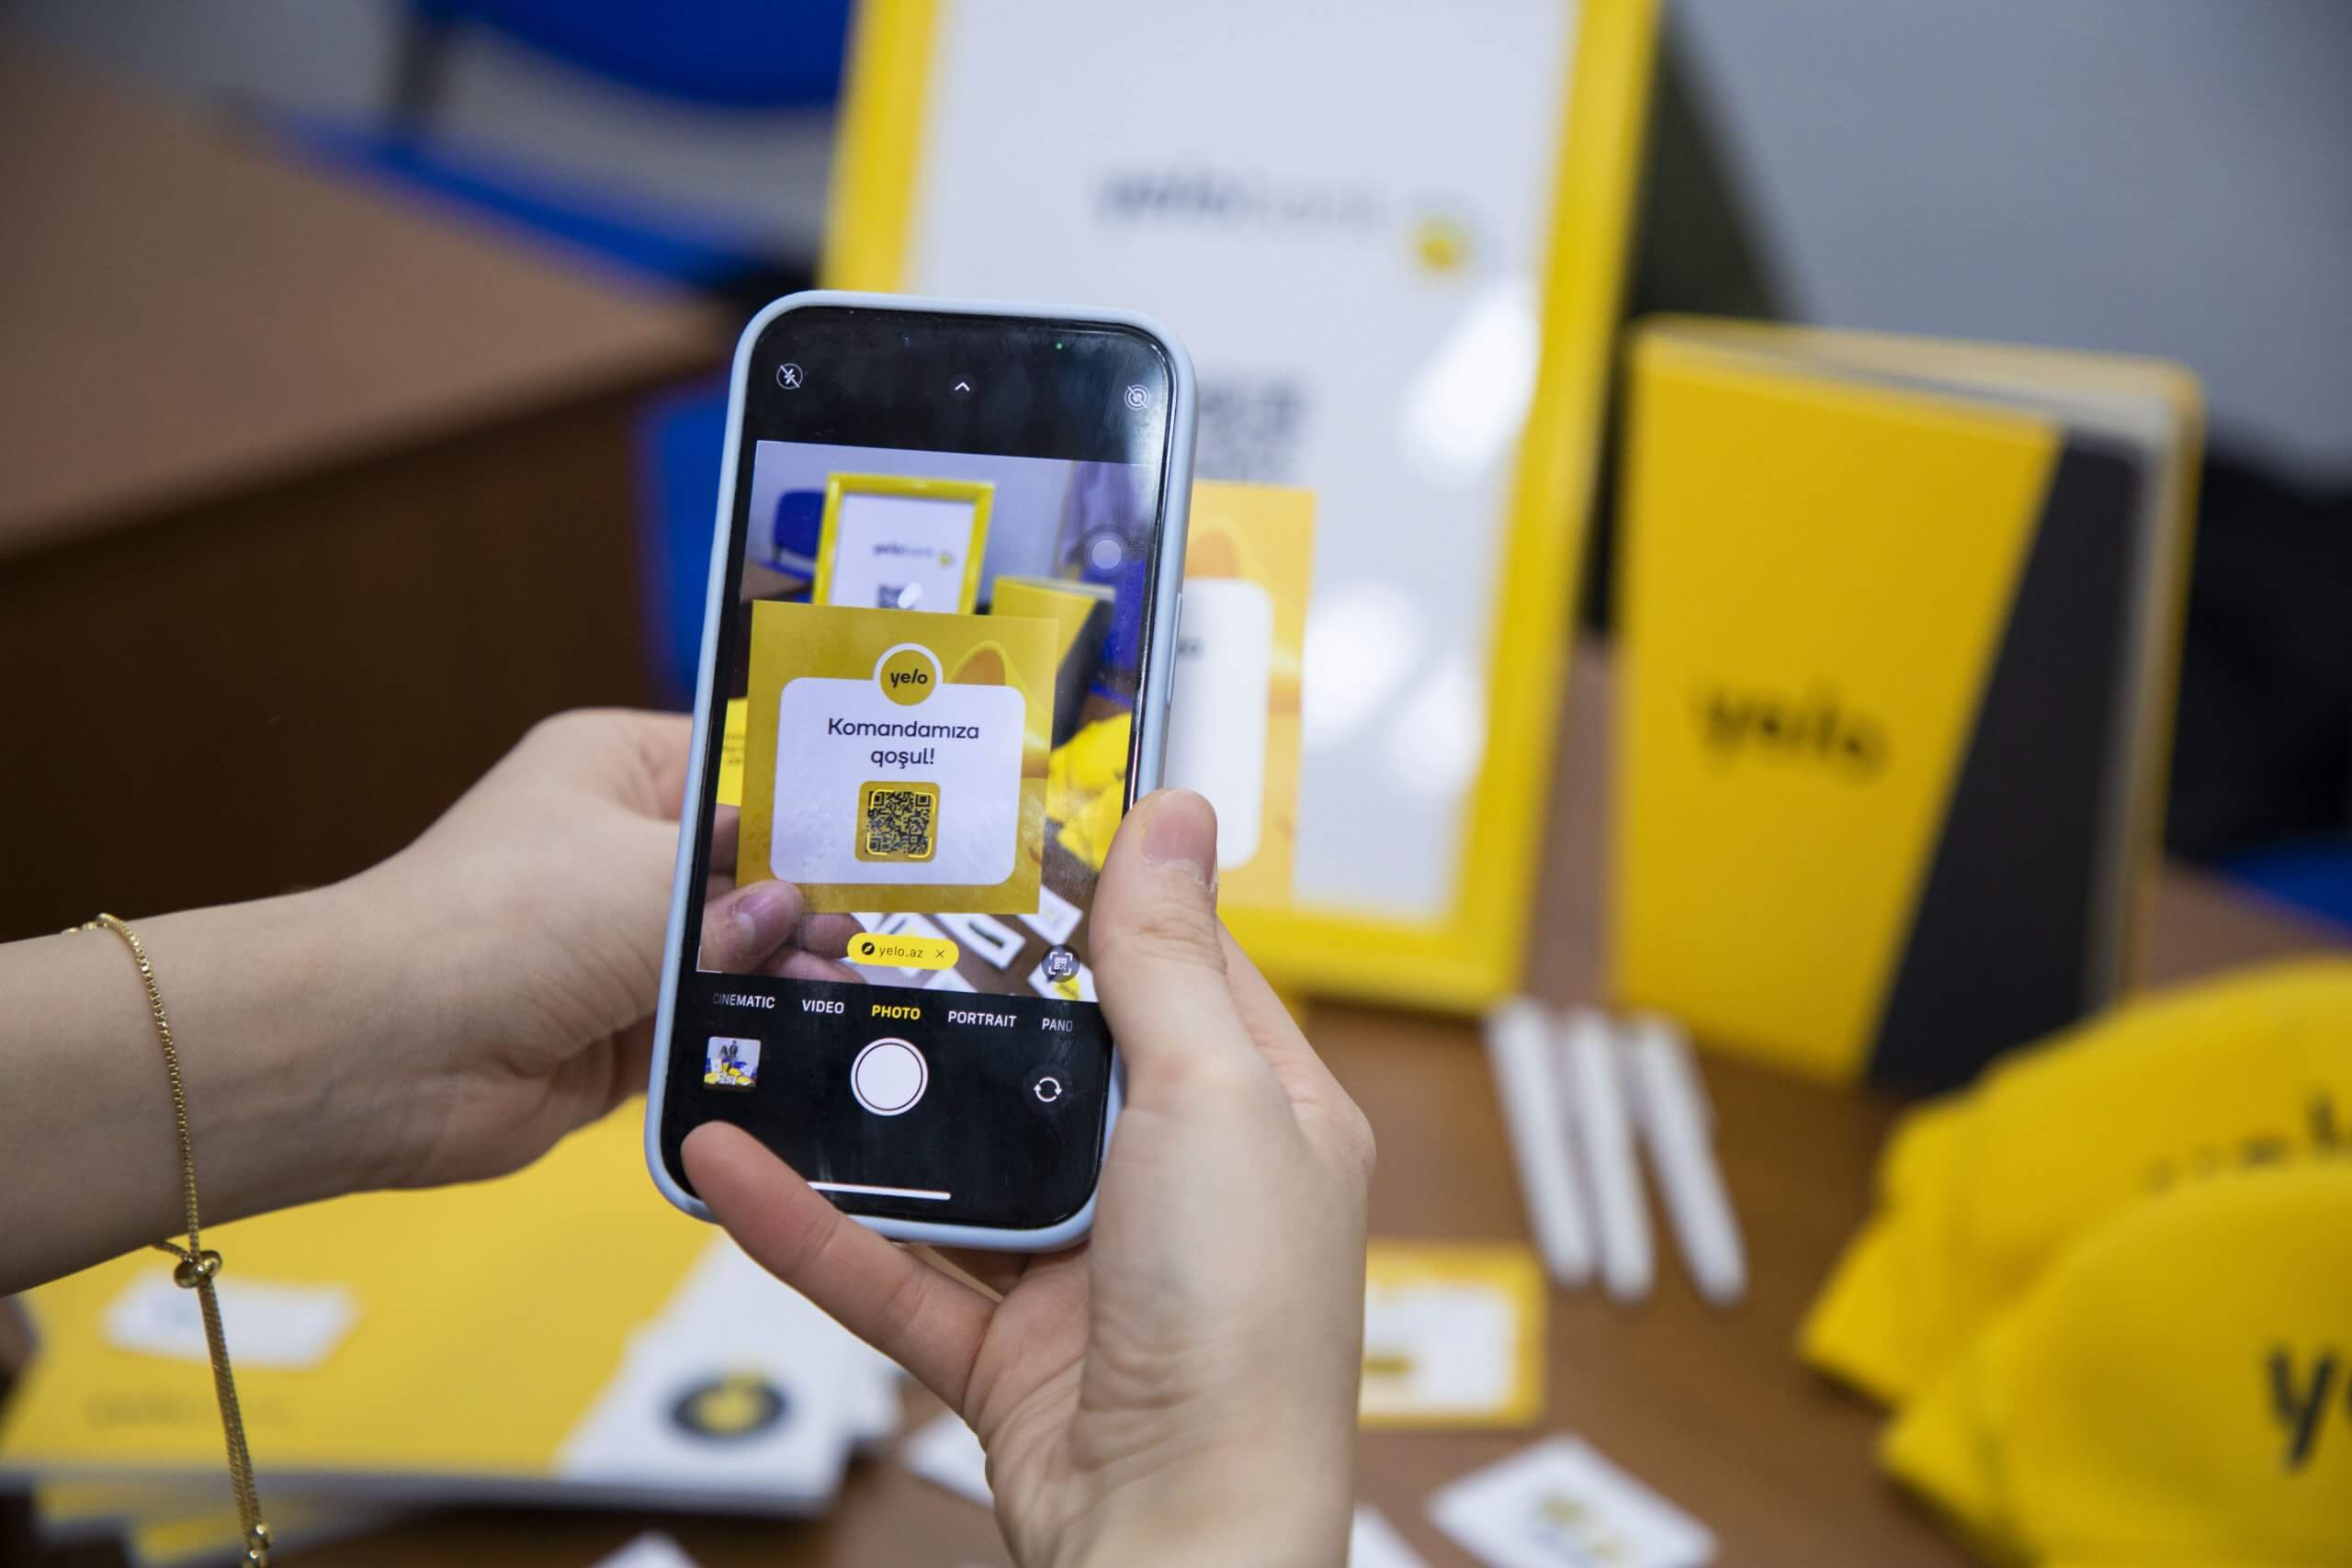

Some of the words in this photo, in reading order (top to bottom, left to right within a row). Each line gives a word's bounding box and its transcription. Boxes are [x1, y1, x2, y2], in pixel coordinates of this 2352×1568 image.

[889, 668, 929, 688] yelo
[827, 717, 979, 739] Komandamıza
[870, 748, 935, 770] qoşul!
[878, 945, 924, 959] yelo.az
[712, 992, 776, 1010] CINEMATIC
[801, 998, 845, 1014] VIDEO
[871, 1004, 922, 1021] PHOTO
[947, 1010, 1018, 1028] PORTRAIT
[1041, 1017, 1074, 1032] PANO
